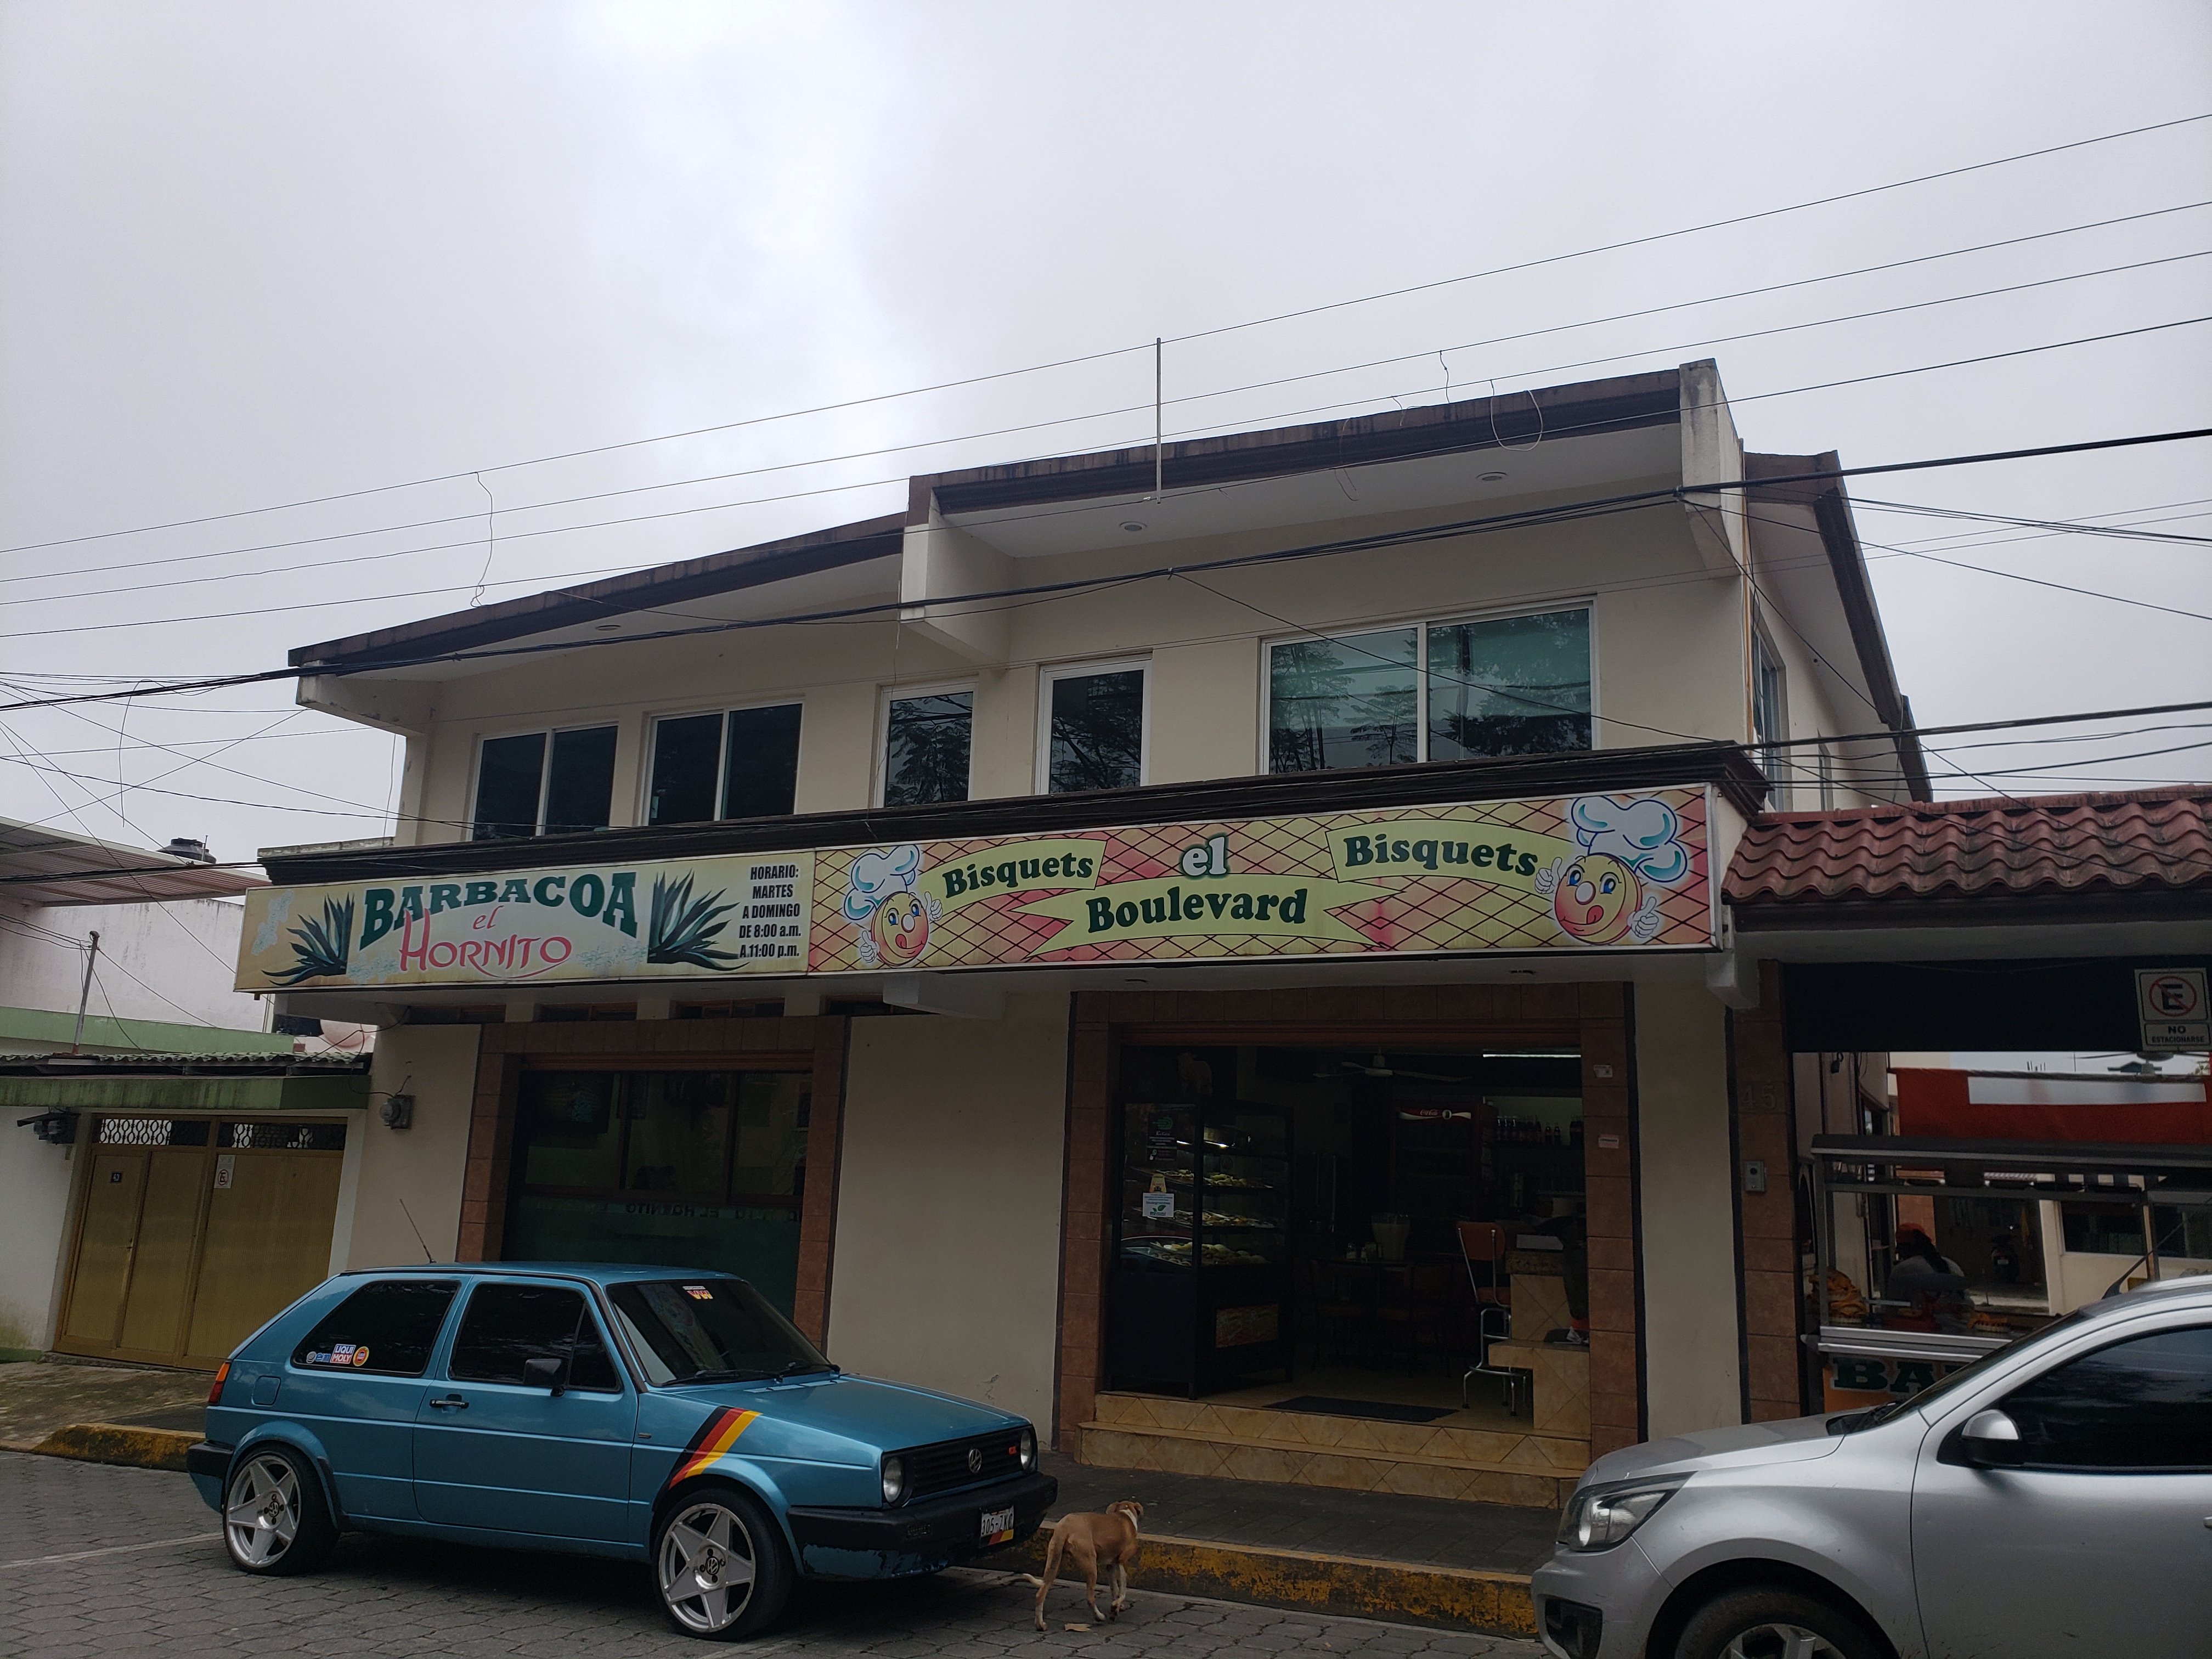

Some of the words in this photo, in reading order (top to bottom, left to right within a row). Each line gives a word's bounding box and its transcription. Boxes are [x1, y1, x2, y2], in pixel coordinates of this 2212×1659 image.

[1182, 836, 1227, 876] el
[1343, 834, 1538, 876] Bisquets
[750, 865, 799, 881] HORARIO:
[942, 852, 1093, 899] Bisquets
[752, 884, 793, 900] MARTES
[359, 872, 637, 951] BARBACOA
[472, 905, 504, 929] el
[742, 905, 750, 919] A
[752, 904, 800, 918] DOMINGO
[1086, 886, 1308, 933] Boulevard
[399, 908, 572, 978] HORNITO
[739, 924, 752, 939] DE
[754, 923, 777, 938] 8:00
[780, 926, 801, 937] a.m.
[748, 943, 775, 958] 11:00
[777, 946, 799, 959] p.m.
[2168, 1026, 2186, 1034] NO
[1742, 1084, 1776, 1112] 45
[331, 1354, 352, 1362] MOLY
[335, 1346, 354, 1354] LIQUI
[1833, 1357, 1963, 1392] BA
